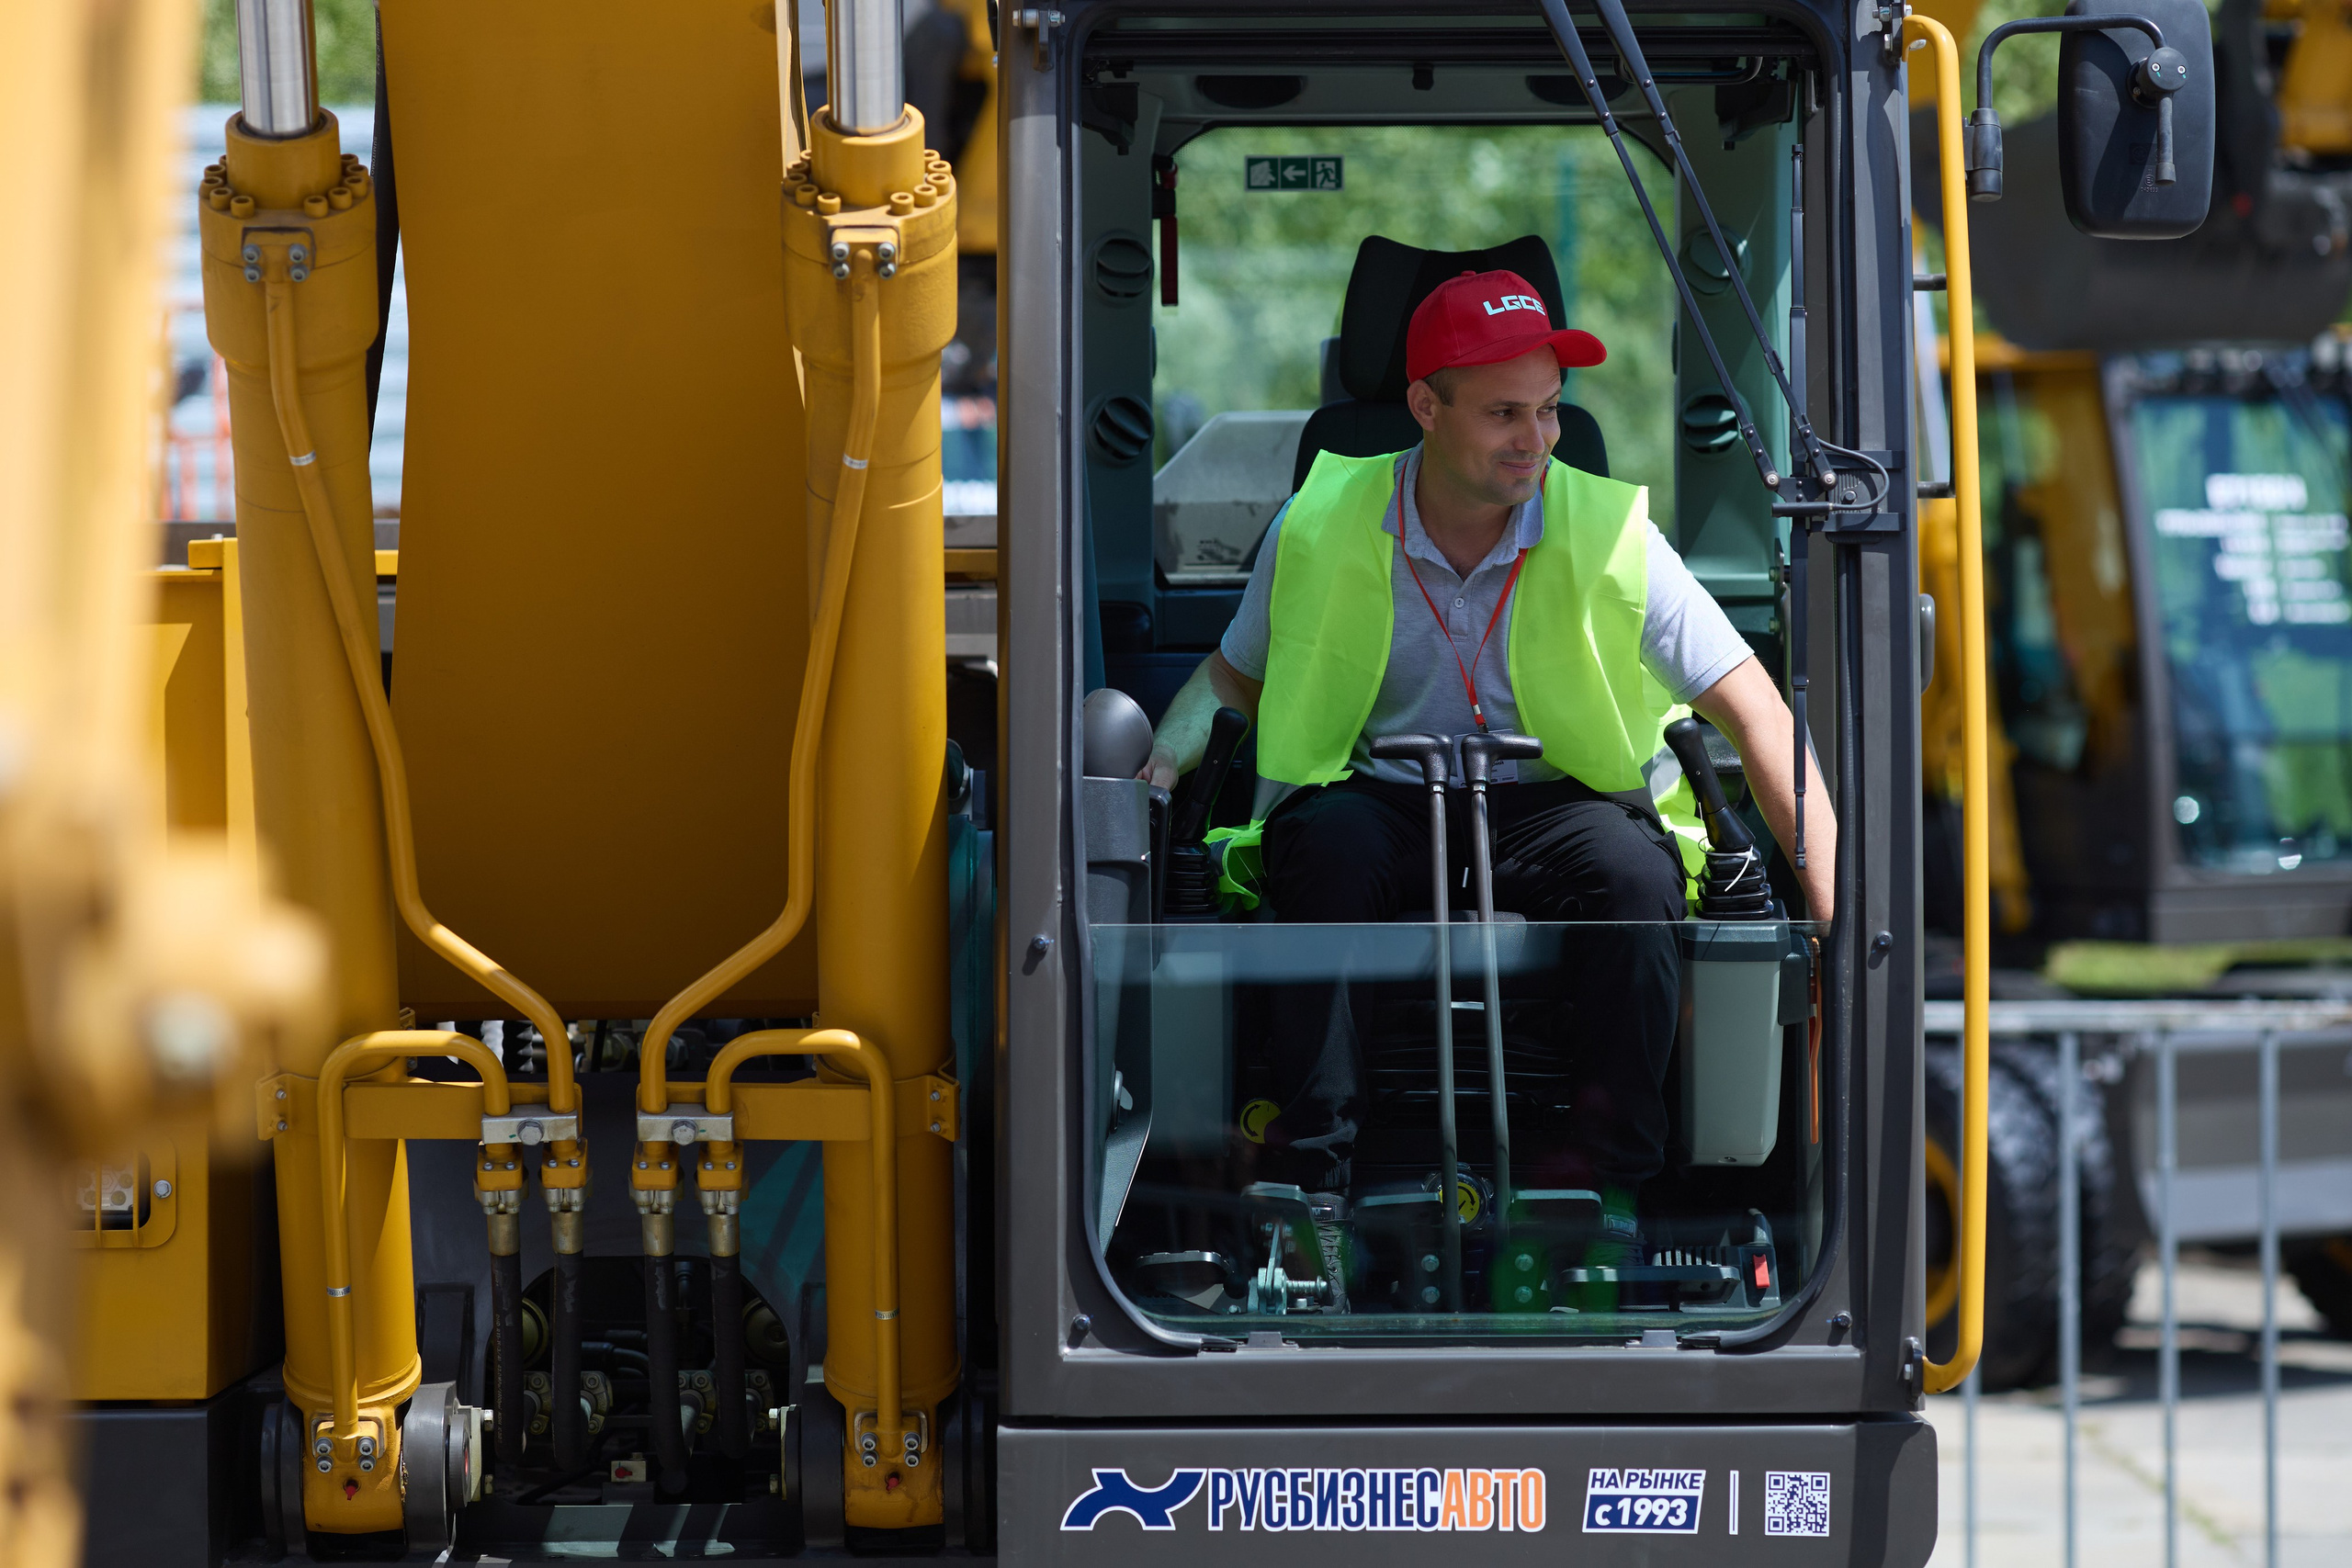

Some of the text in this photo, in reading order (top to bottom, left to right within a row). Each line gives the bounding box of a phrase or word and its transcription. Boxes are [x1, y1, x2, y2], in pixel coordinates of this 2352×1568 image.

[1590, 1472, 1702, 1490] НА РЫНКЕ
[1210, 1469, 1544, 1530] РУСБИЗНЕСАВТО
[1617, 1497, 1689, 1527] 1993
